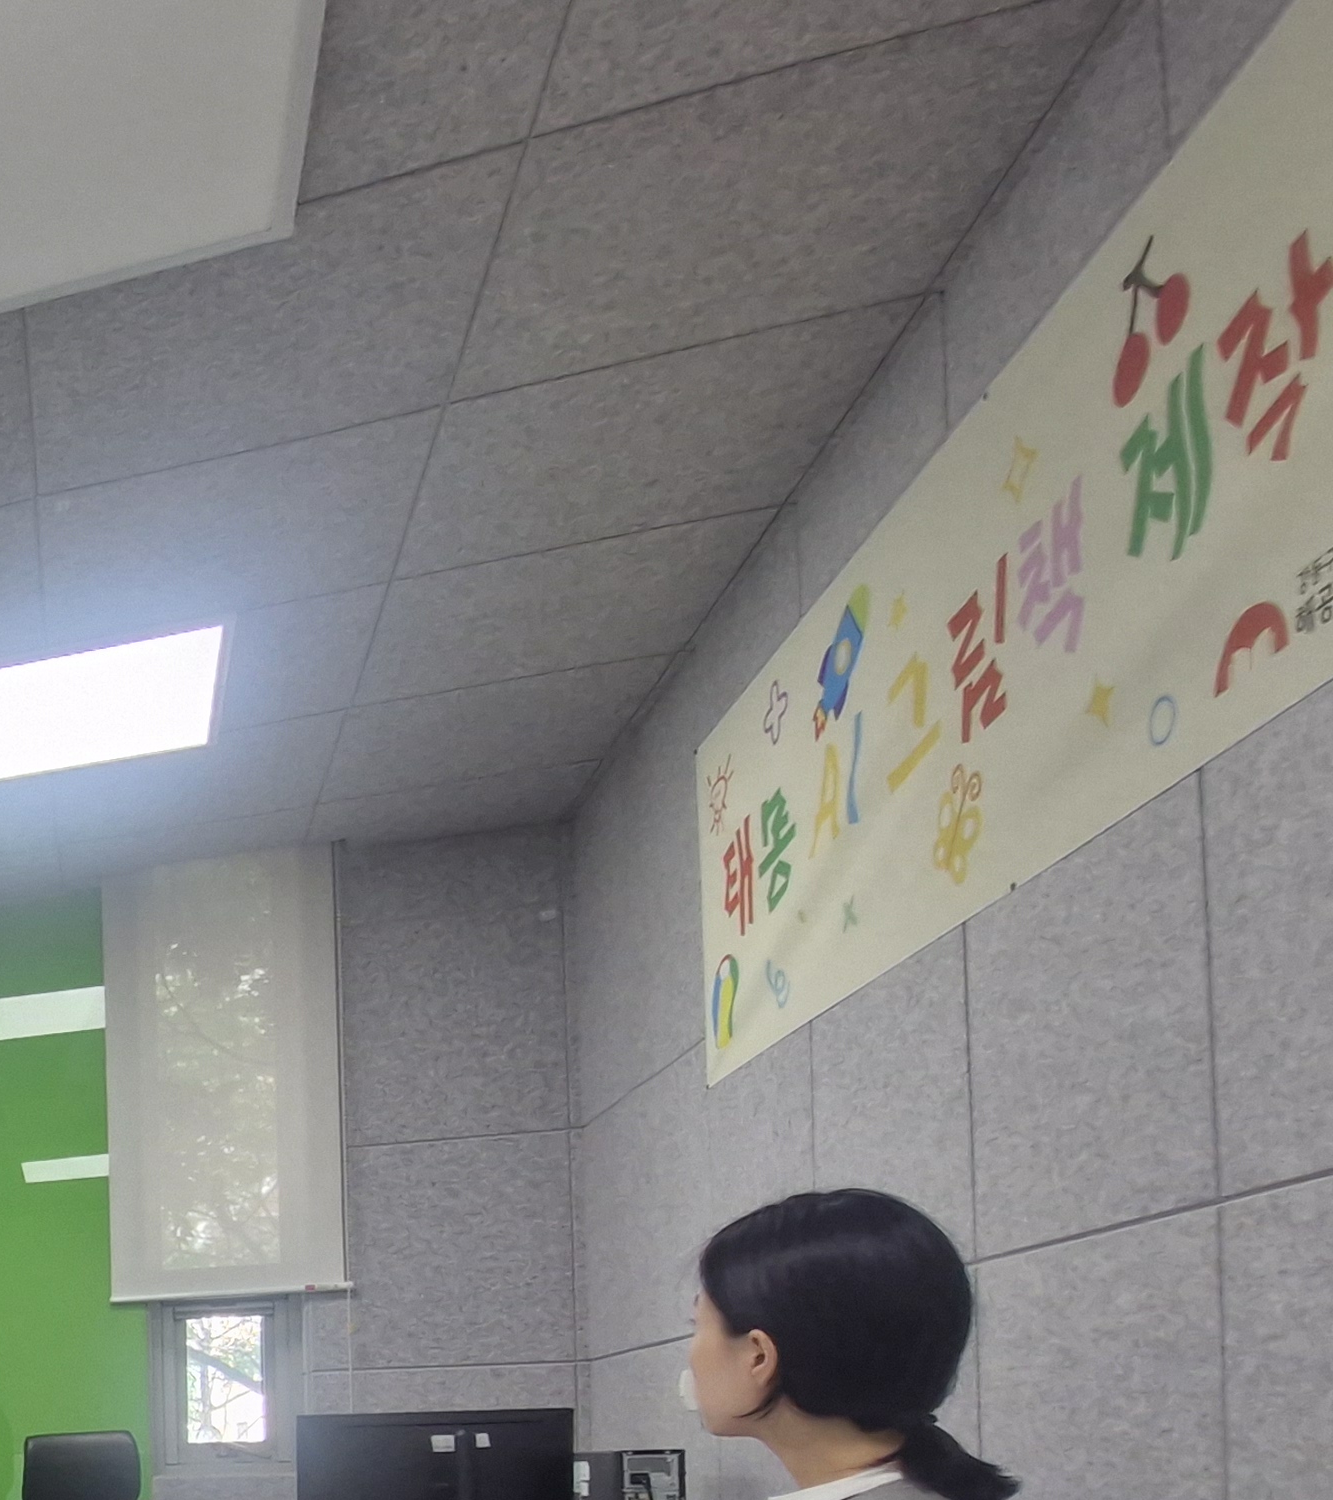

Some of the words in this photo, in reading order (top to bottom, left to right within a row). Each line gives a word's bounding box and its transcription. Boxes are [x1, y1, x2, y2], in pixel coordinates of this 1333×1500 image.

[723, 787, 796, 936] 태몽
[809, 711, 862, 860] AI
[887, 475, 1084, 794] 그림책
[1120, 228, 1333, 561] 제작
